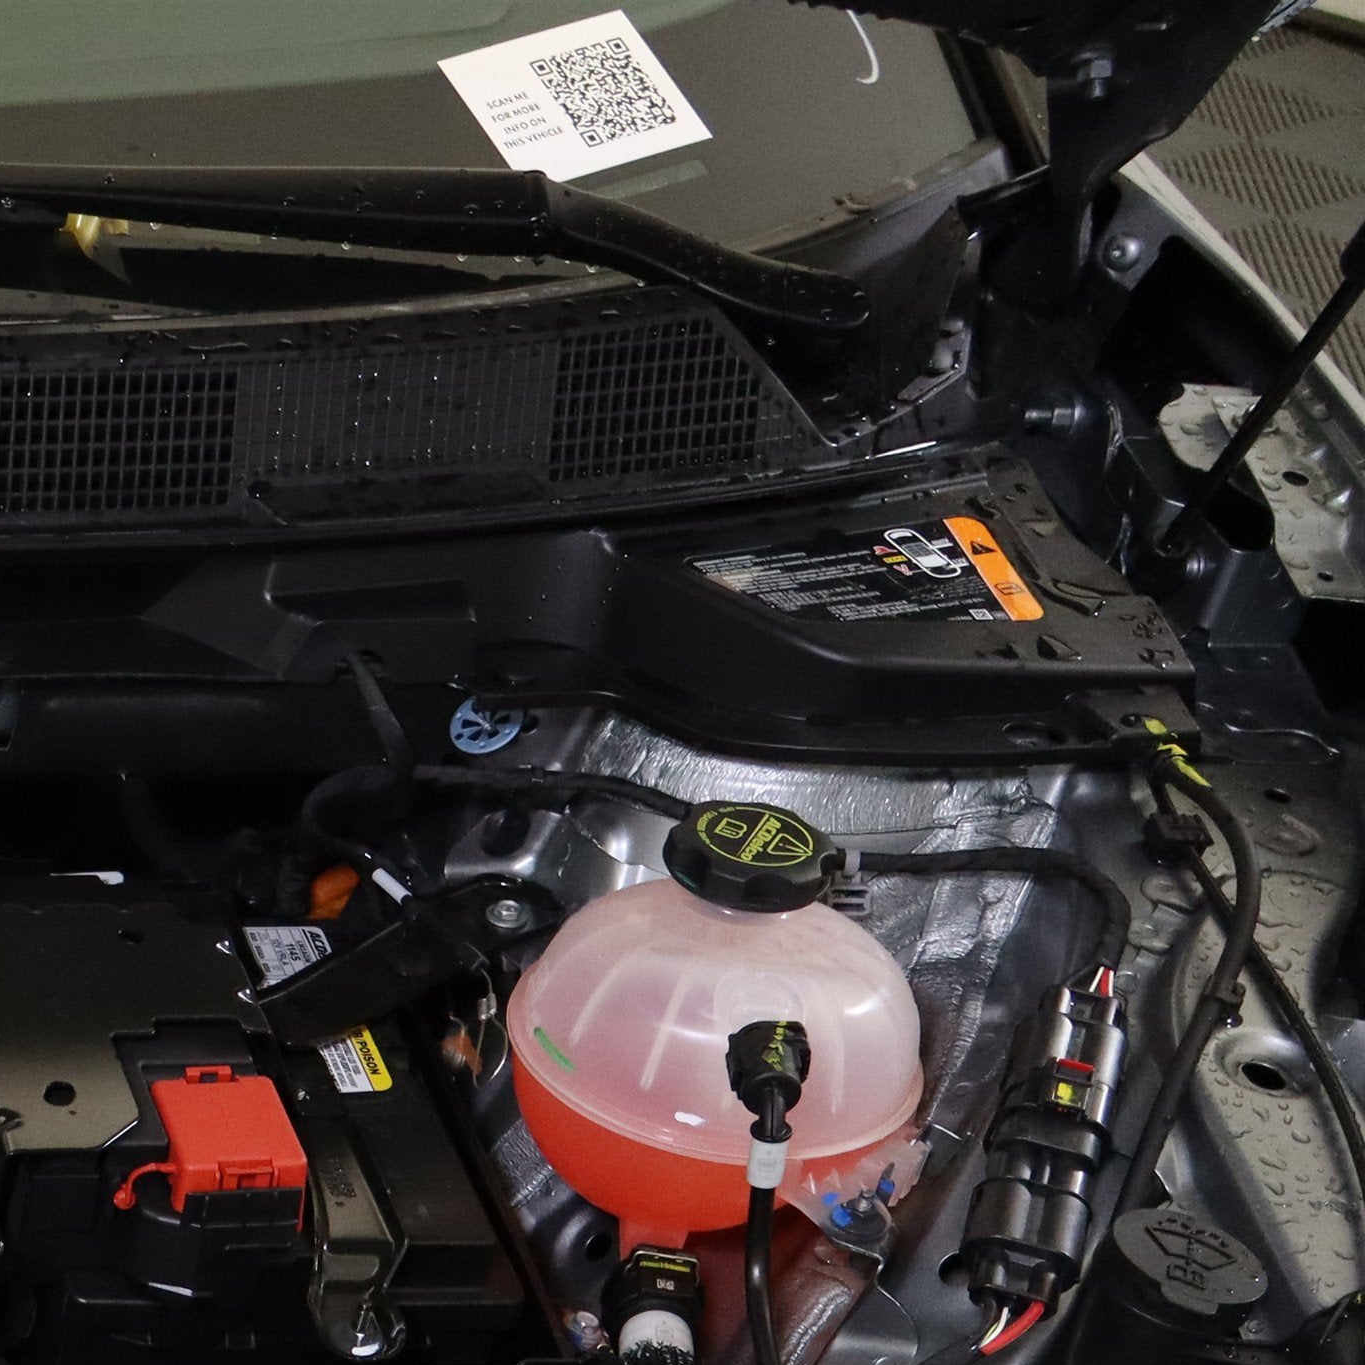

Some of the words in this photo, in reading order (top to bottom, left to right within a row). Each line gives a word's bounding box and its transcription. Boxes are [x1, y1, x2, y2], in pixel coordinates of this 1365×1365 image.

[486, 96, 513, 109] SCAN
[513, 92, 529, 101] ME
[491, 112, 513, 123] FOR
[512, 103, 541, 116] MORE
[503, 121, 529, 135] INFO
[529, 116, 547, 127] ON
[503, 138, 526, 149] THIS
[525, 126, 564, 143] VEHICLE
[740, 816, 782, 861] ACDelco
[285, 943, 301, 961] 1145
